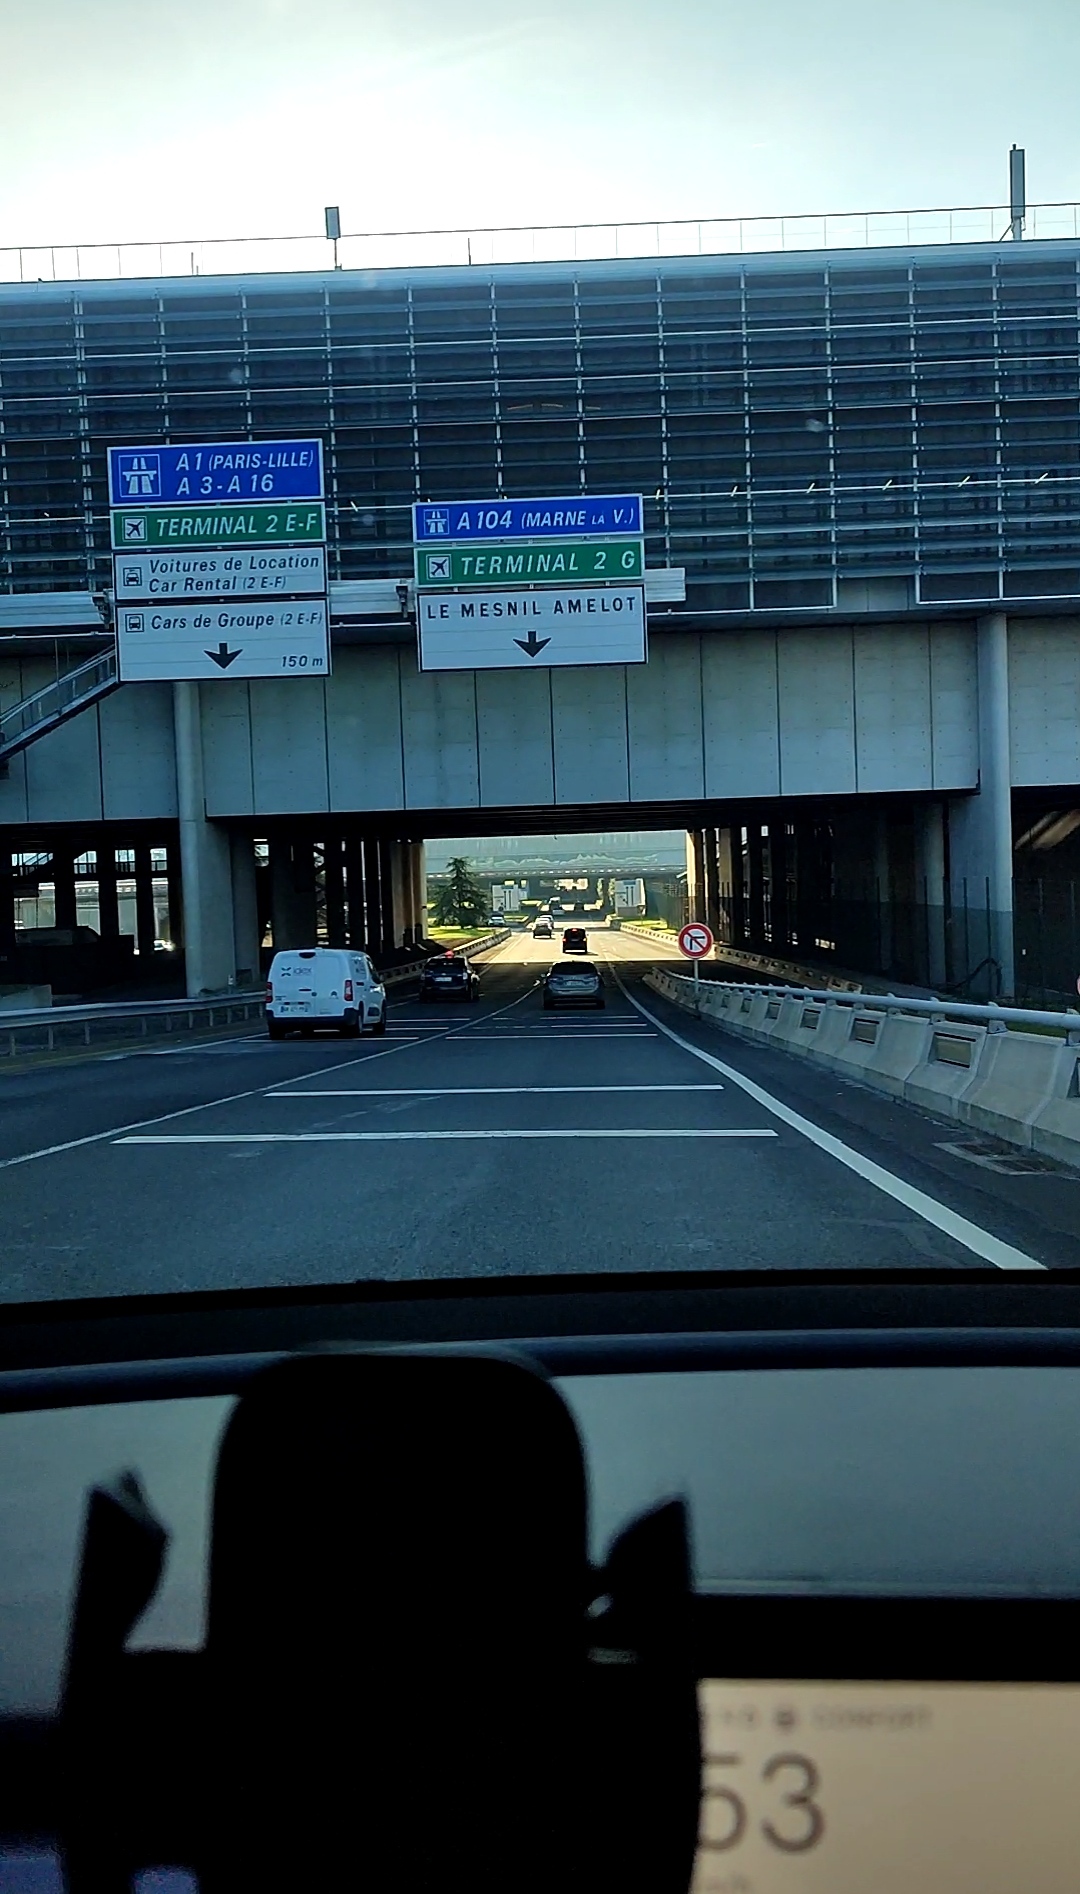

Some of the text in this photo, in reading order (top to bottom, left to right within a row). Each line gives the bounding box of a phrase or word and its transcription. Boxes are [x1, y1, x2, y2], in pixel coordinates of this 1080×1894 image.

[209, 450, 314, 472] (PARIS-LILLE)
[156, 513, 318, 536] TERMINAL 2 E-F
[477, 509, 513, 529] 104
[521, 510, 586, 529] (MARNE
[613, 507, 634, 524] V.)
[149, 554, 319, 574] Voitures de Location
[461, 550, 636, 575] TERMINAL 2 G
[149, 579, 177, 593] Car
[184, 575, 237, 591] Rental
[427, 596, 636, 619] LE MESNIL AMELOT
[151, 615, 187, 630] Cars
[193, 614, 211, 628] de
[218, 611, 274, 630] Groupe
[282, 655, 323, 668] 150 m
